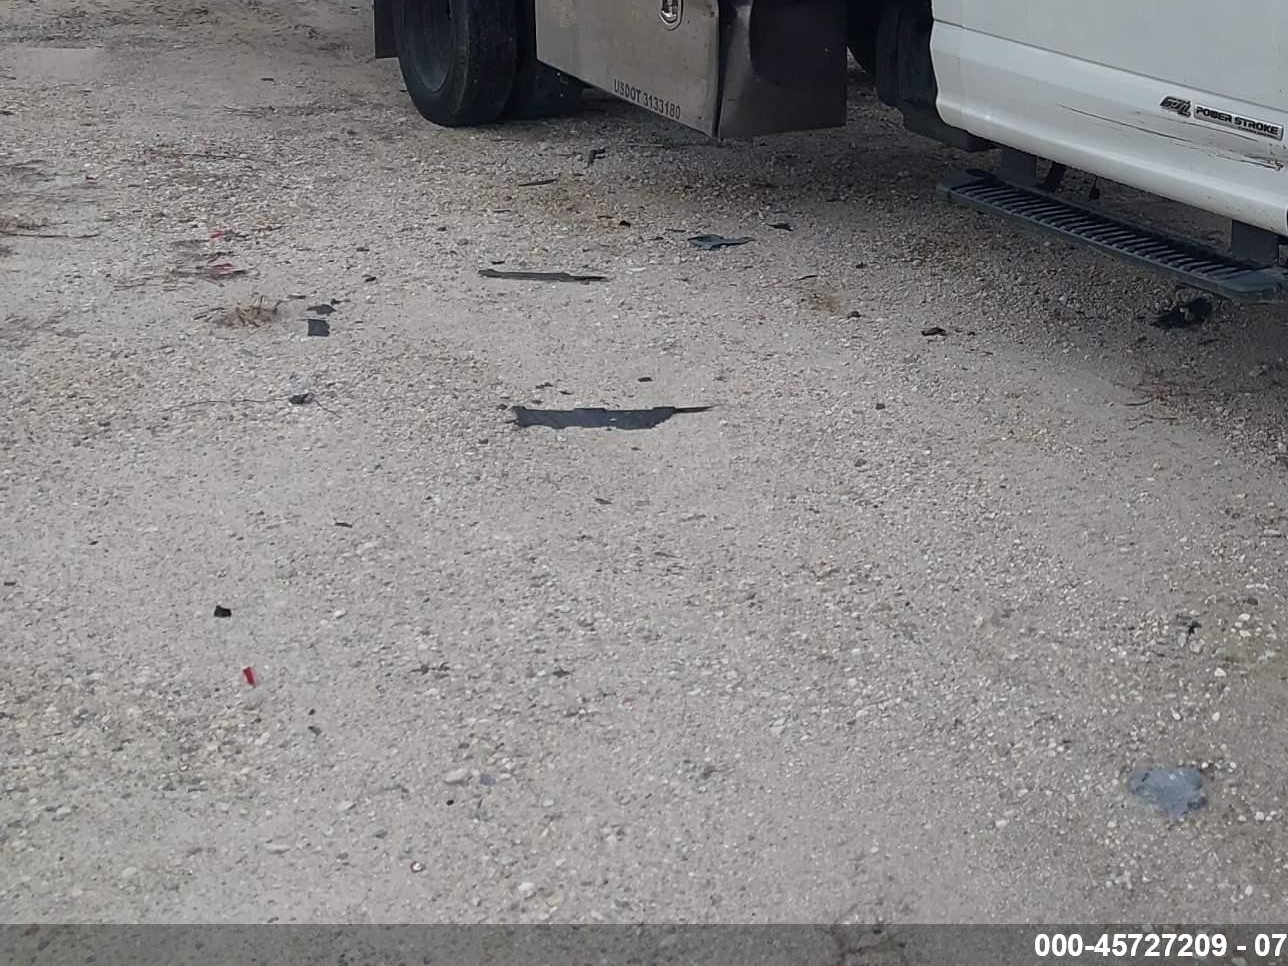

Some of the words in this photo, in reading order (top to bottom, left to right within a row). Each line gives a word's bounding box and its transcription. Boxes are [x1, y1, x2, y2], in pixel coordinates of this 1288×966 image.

[613, 78, 641, 104] USDOT
[643, 92, 681, 120] 3133180
[1195, 105, 1233, 123] POWER
[1233, 115, 1279, 136] STROKE
